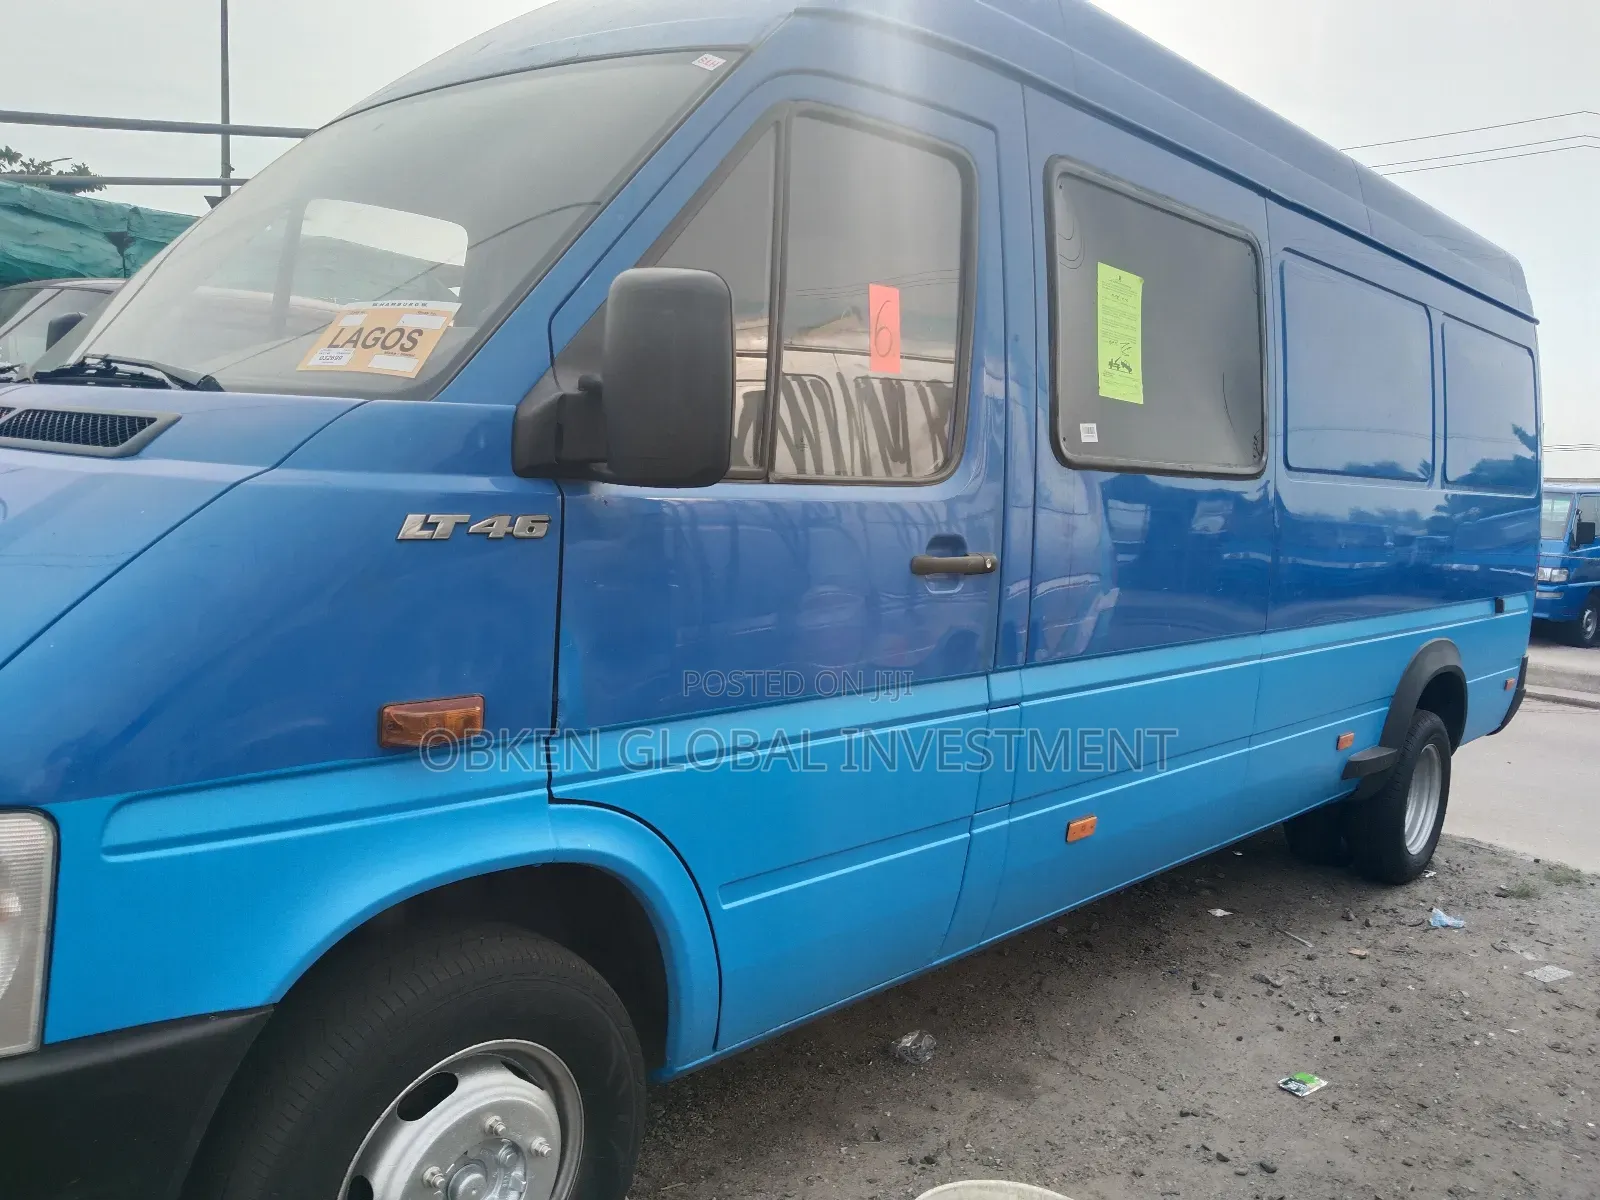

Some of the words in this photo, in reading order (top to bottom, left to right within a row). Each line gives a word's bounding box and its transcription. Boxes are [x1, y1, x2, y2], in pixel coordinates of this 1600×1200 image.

[327, 326, 424, 352] LAGOS
[874, 299, 894, 358] 6
[396, 512, 471, 541] LT
[467, 513, 551, 540] 46
